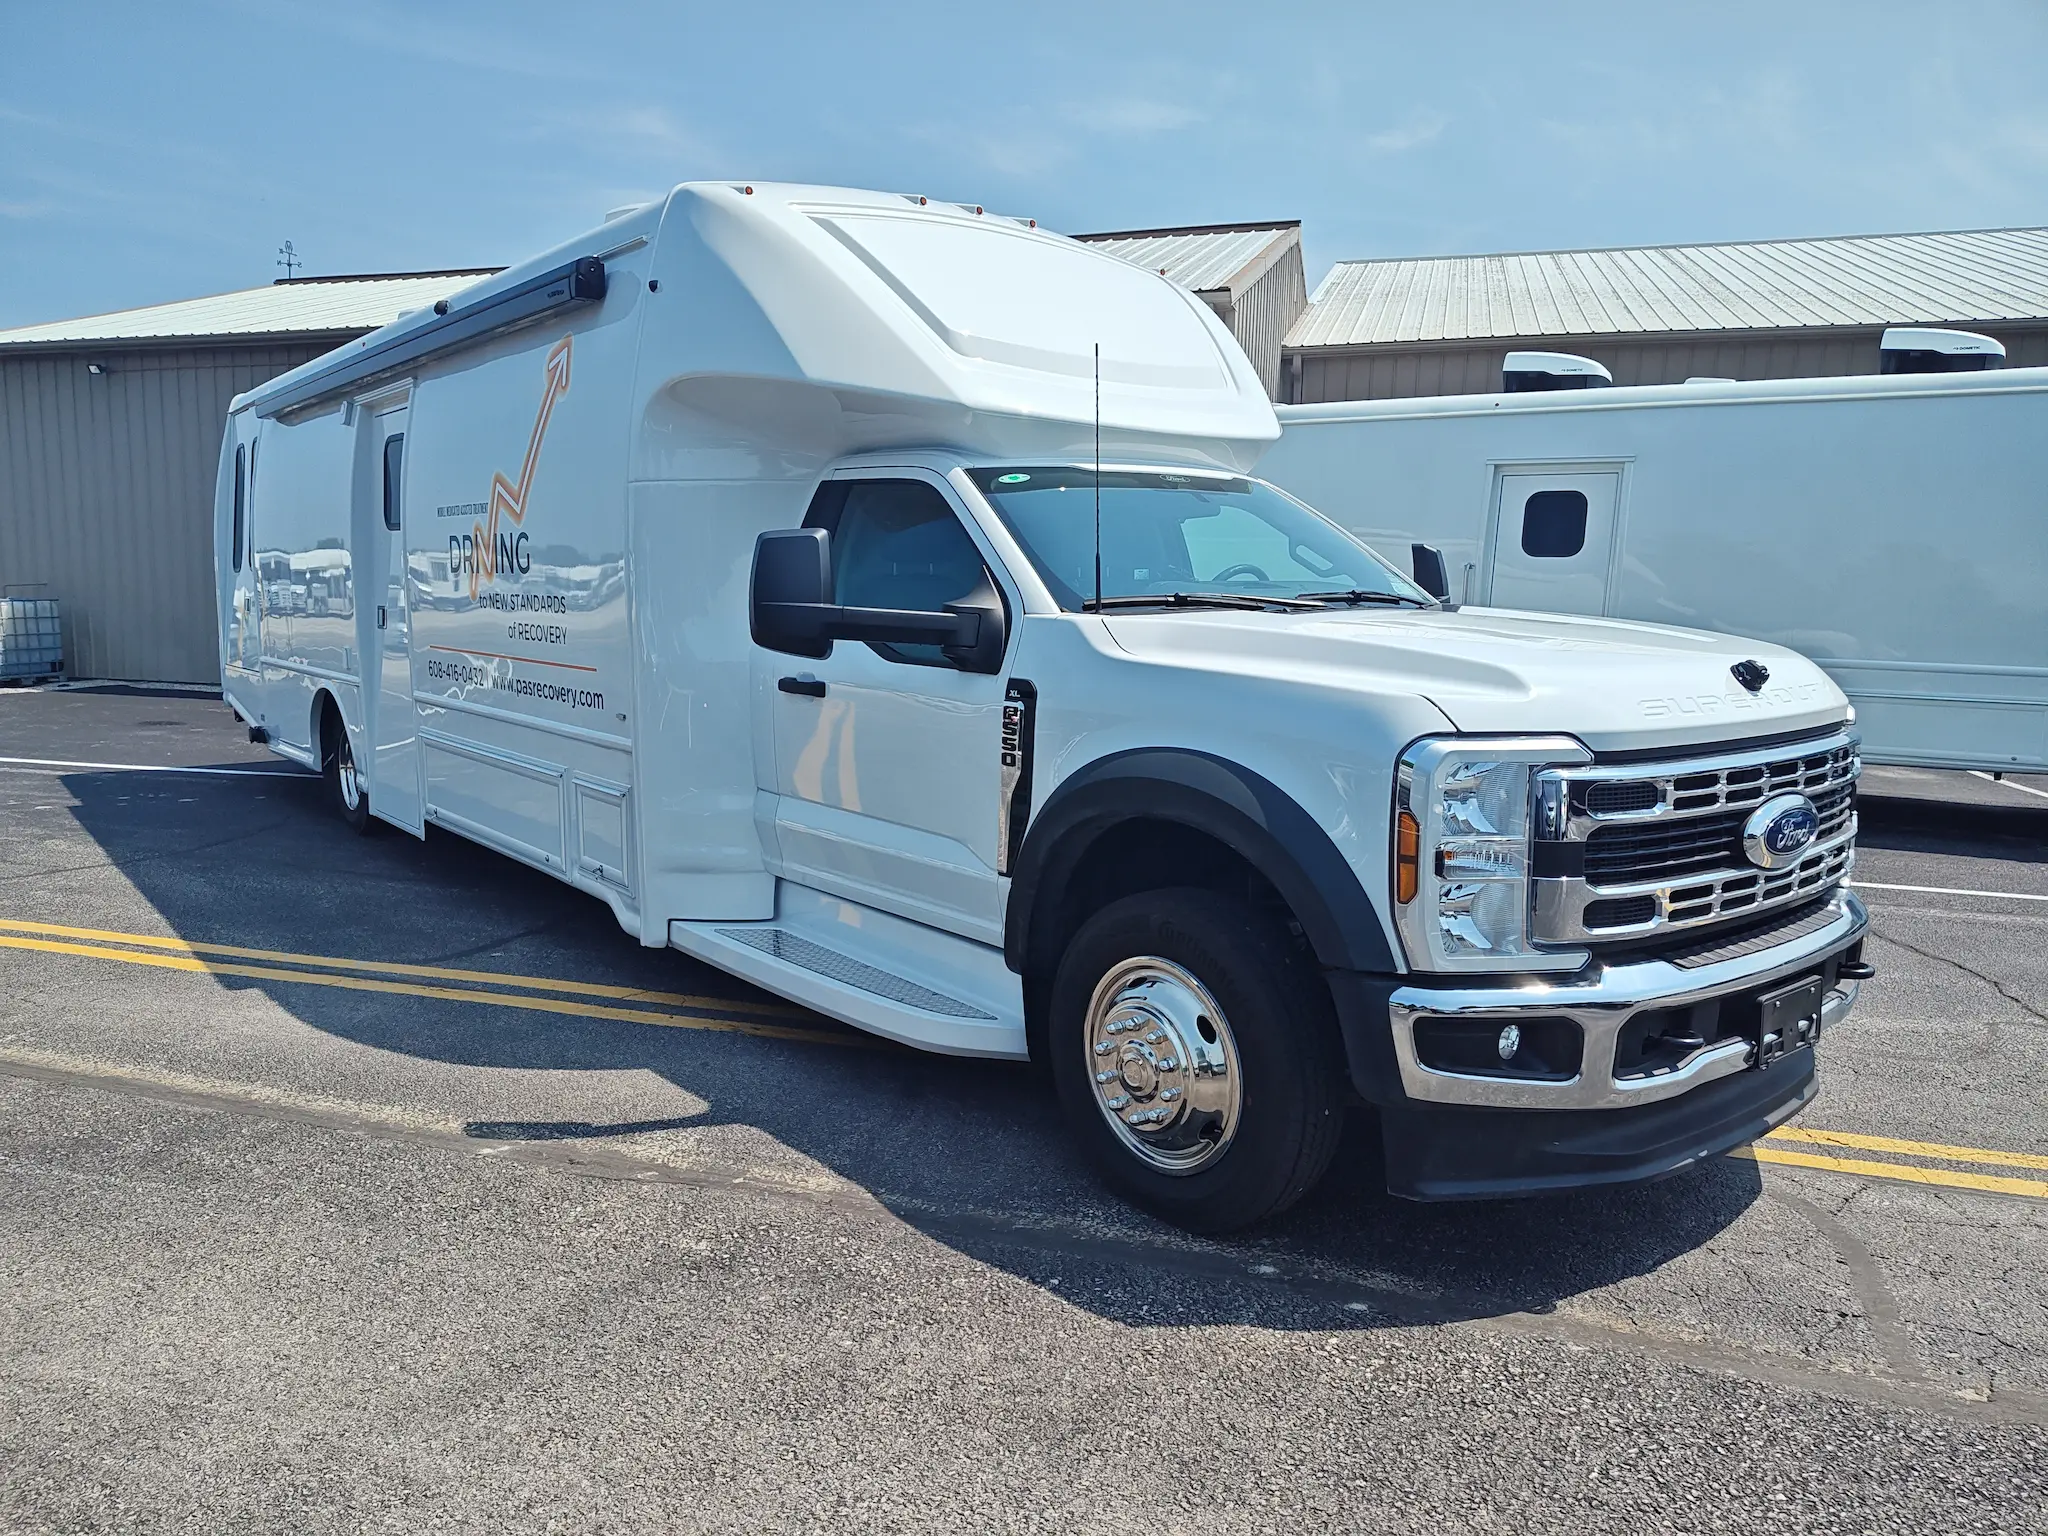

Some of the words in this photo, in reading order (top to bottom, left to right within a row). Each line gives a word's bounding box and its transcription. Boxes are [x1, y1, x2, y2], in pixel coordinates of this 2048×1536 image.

[479, 594, 488, 609] to
[488, 592, 509, 610] NEW
[510, 593, 567, 615] STANDARDS
[507, 621, 517, 639] of
[517, 622, 568, 645] RECOVERY
[428, 659, 484, 687] 608-416-0432
[491, 673, 605, 710] www.pasrecovery.com
[1008, 689, 1021, 698] XL
[1776, 814, 1811, 850] Ford
